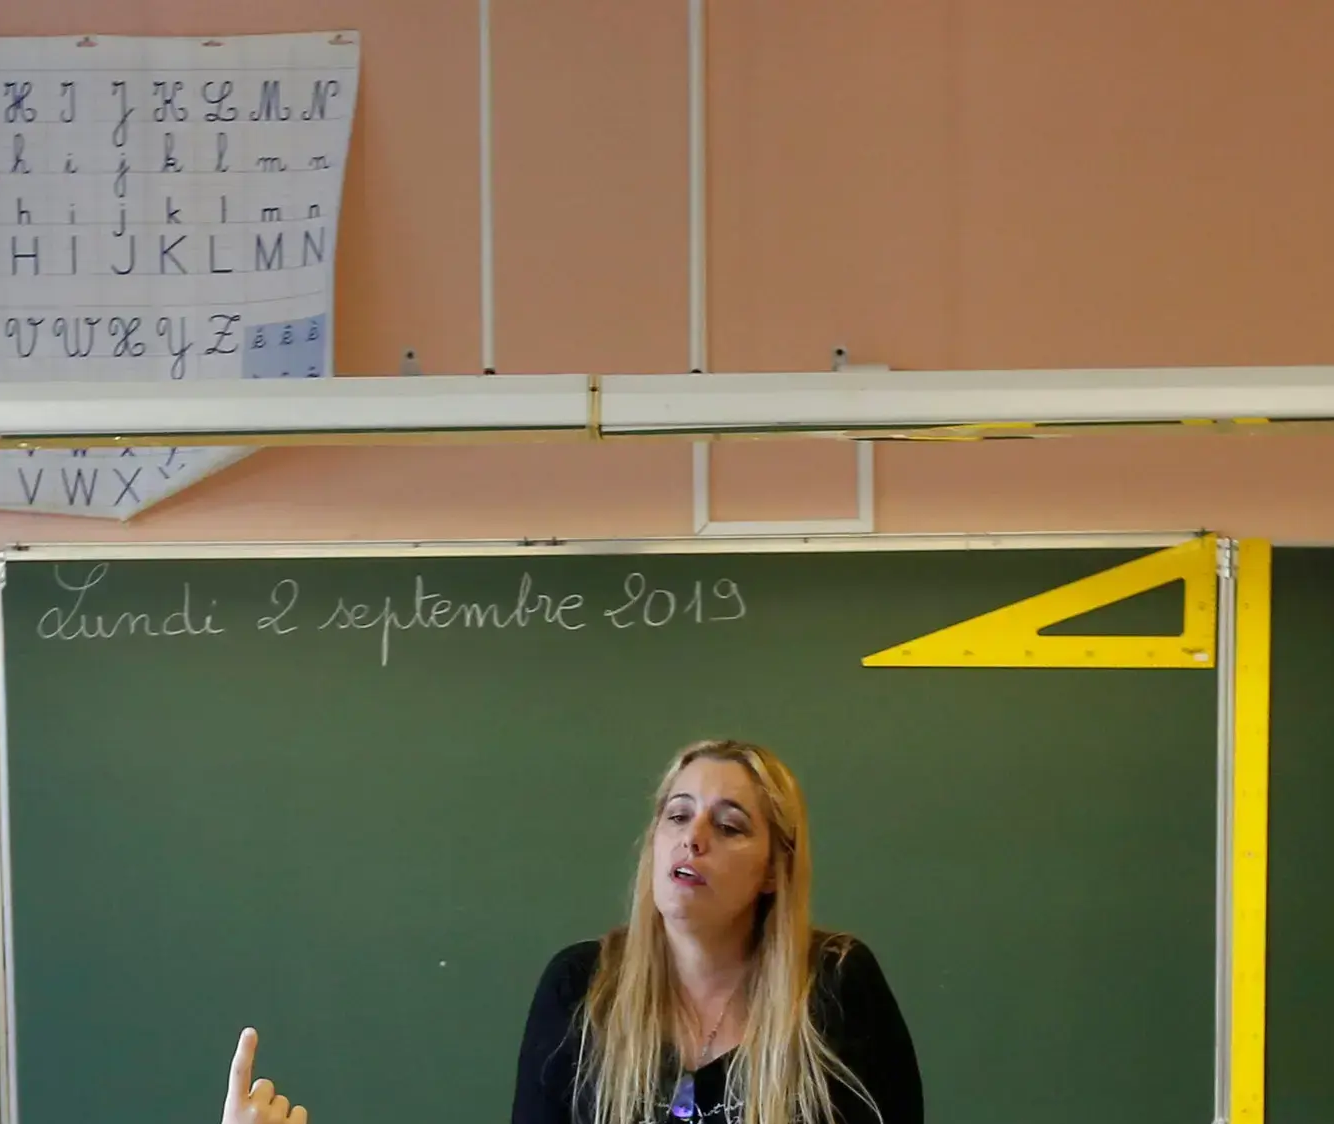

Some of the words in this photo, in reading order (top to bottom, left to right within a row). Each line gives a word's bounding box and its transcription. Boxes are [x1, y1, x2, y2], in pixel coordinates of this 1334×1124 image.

[37, 562, 224, 641] Lundi
[258, 578, 299, 635] 2
[318, 572, 586, 666] septembre
[604, 571, 746, 630] 2019
